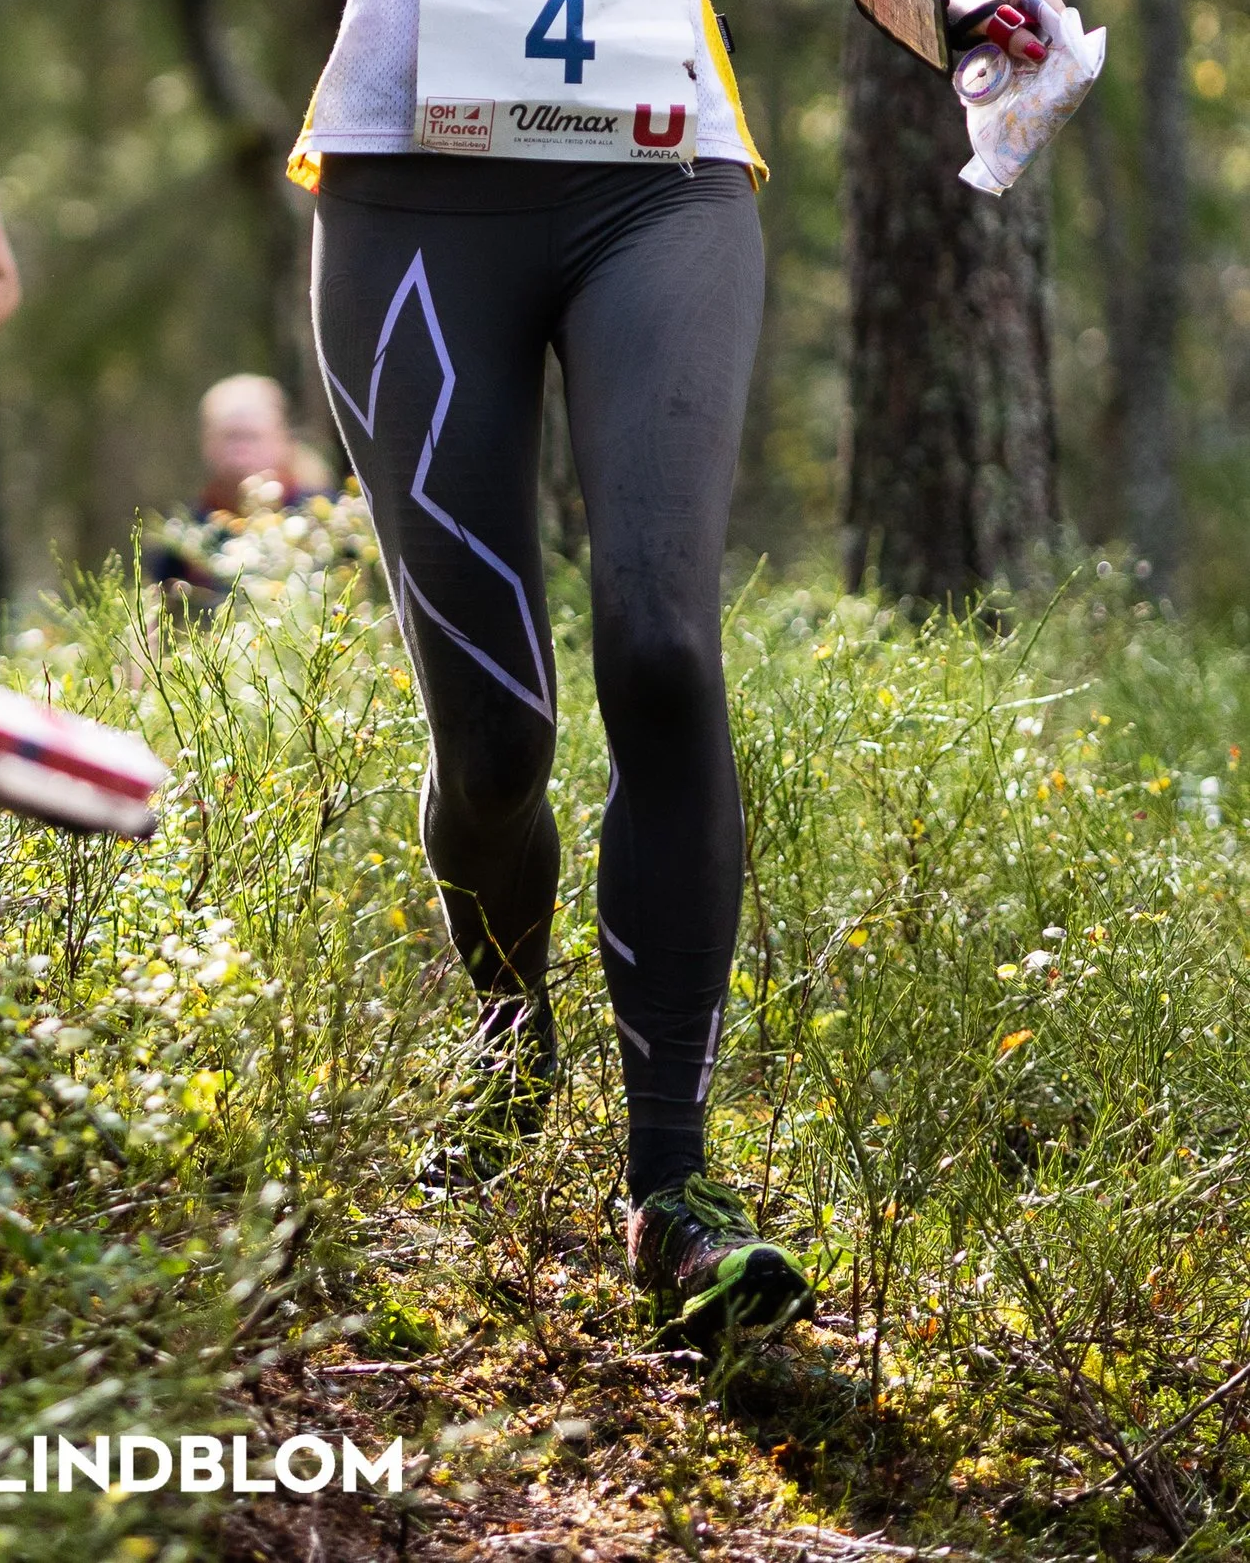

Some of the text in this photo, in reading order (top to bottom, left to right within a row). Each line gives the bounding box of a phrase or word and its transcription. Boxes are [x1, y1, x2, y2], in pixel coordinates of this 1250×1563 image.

[509, 103, 619, 134] Ullmax
[429, 120, 489, 136] Tisaren
[630, 148, 680, 160] UMARA
